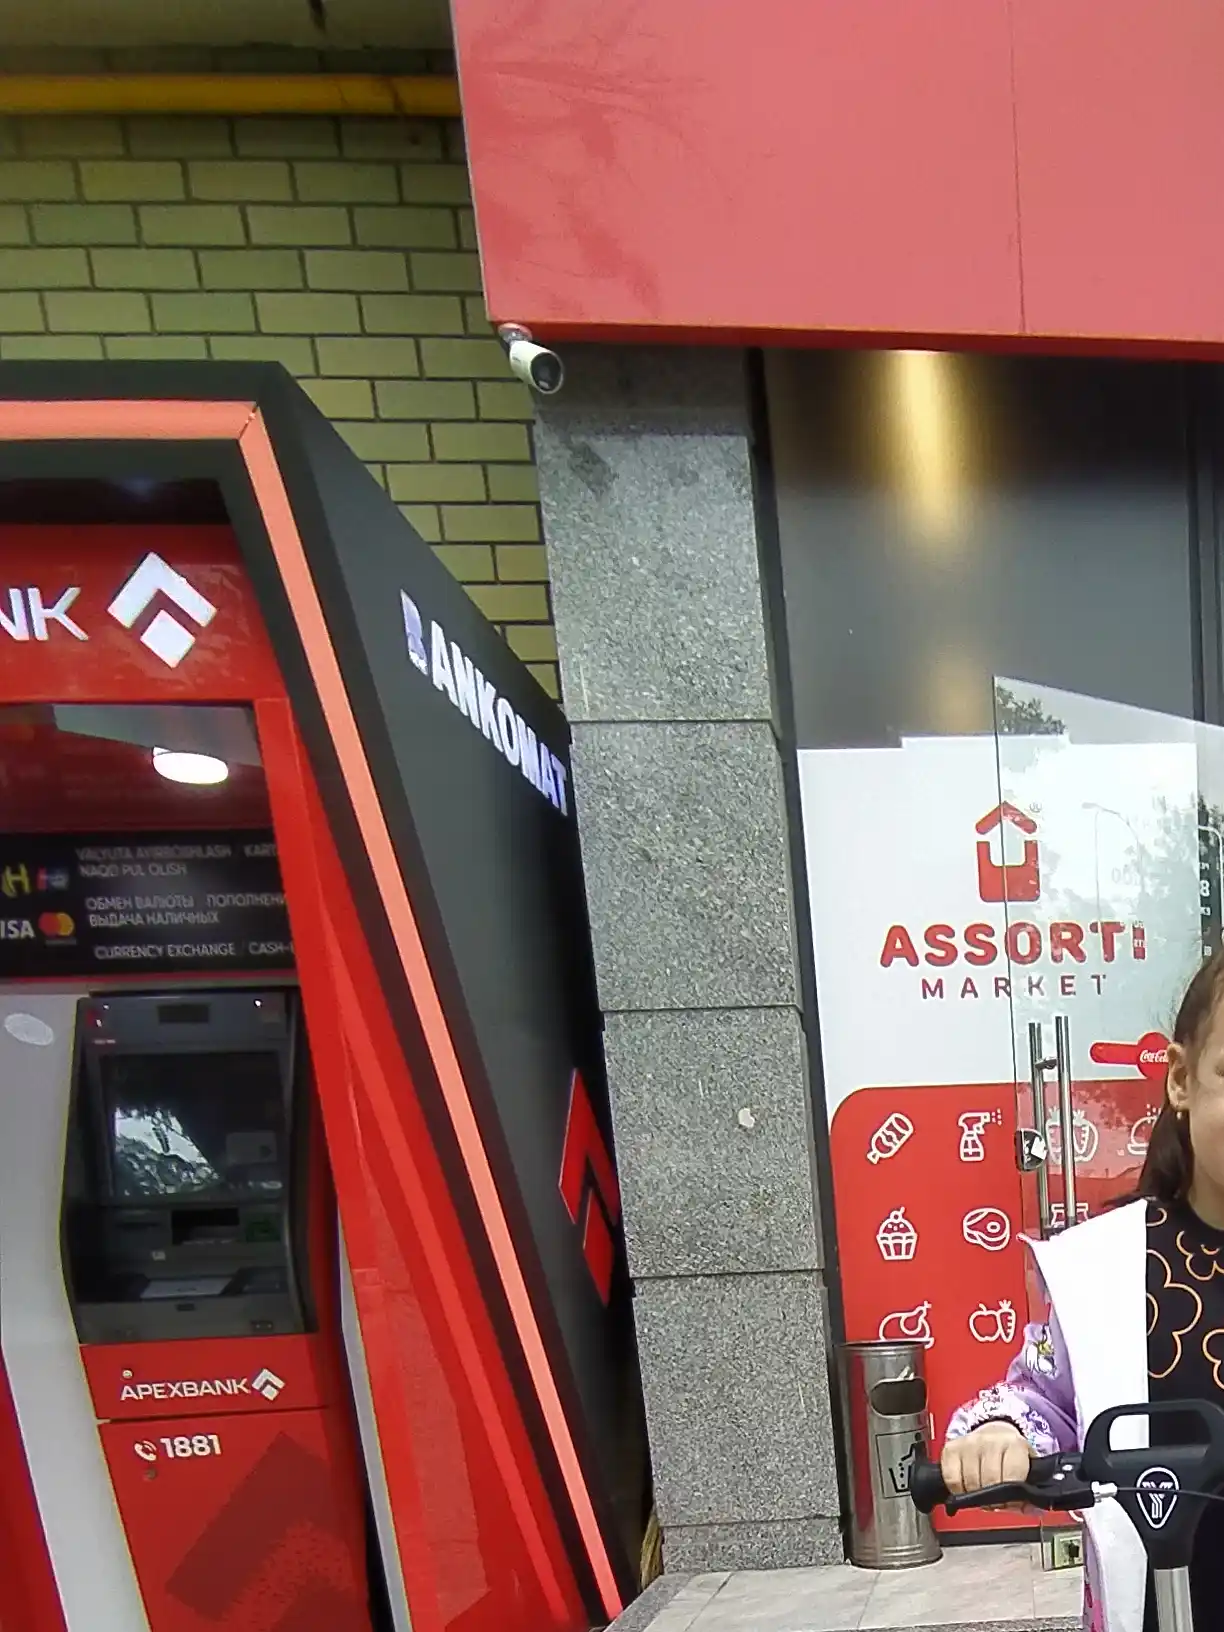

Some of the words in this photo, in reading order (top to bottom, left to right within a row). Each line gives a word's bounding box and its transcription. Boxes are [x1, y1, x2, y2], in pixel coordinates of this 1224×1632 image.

[880, 920, 1147, 968] ASSORTI
[921, 974, 1107, 999] MARKET
[120, 1377, 252, 1401] APEXBANK
[159, 1433, 222, 1459] 1881
